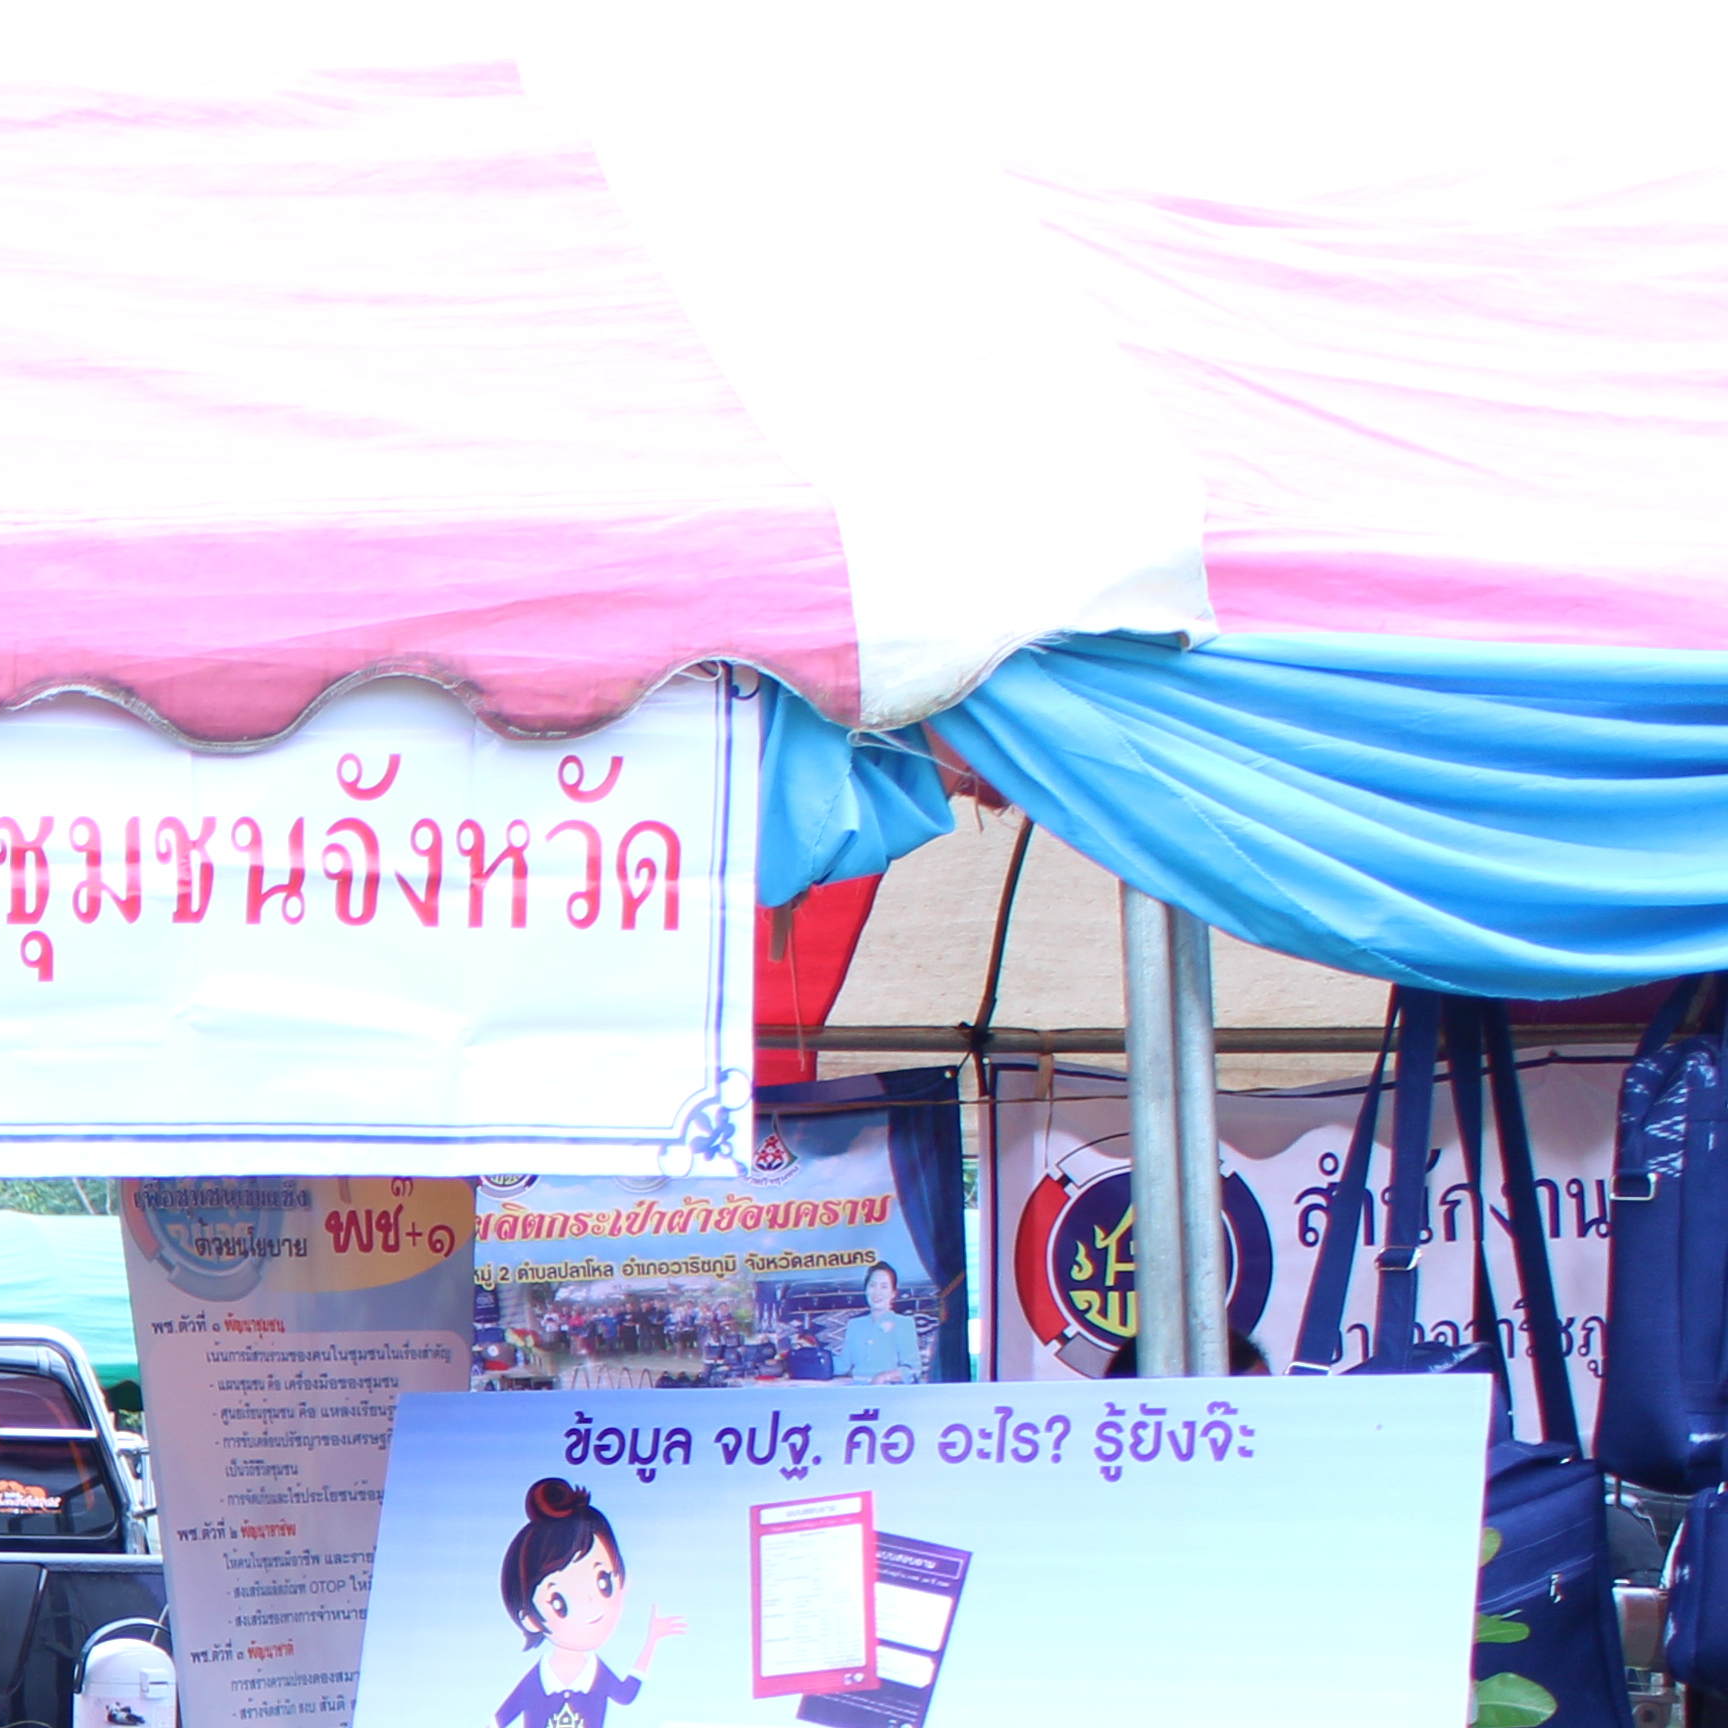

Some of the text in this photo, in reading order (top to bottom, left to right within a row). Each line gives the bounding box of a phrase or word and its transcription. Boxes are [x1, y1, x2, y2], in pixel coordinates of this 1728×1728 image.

[1294, 1148, 1612, 1248] สำกาน
[194, 1222, 308, 1258] ด้วยนโยบาย
[499, 1249, 877, 1282] 2 ตำบลปลาโหล อำเภอวาริชภูมิ จังหวัดสกลนคร
[151, 1311, 207, 1335] พช.ตัวที่
[564, 1400, 1256, 1483] ข้อมูล จปฐ. คือ อะไร? รู้ยังจ๊ะ
[309, 1580, 346, 1594] OTOP
